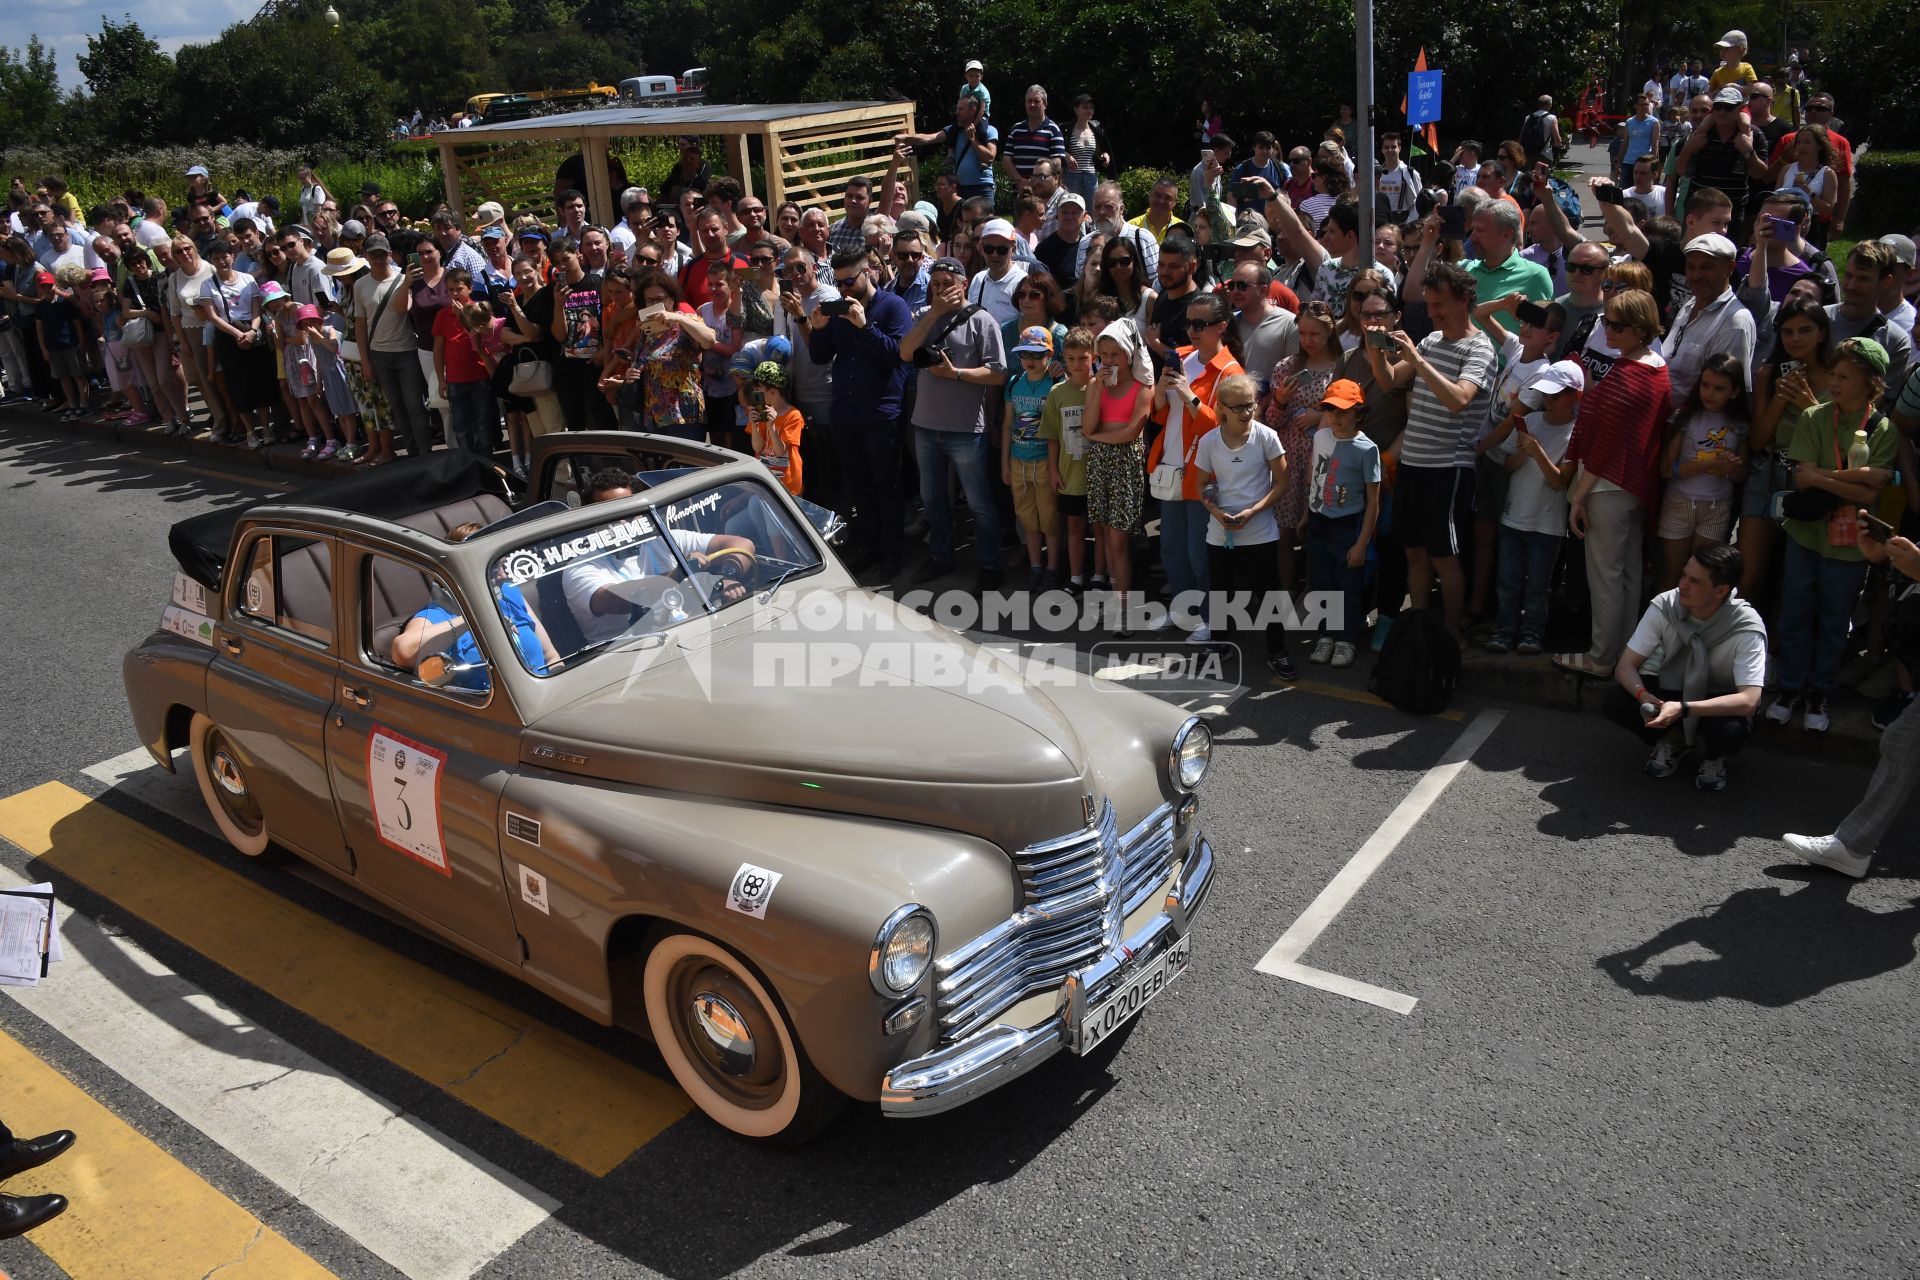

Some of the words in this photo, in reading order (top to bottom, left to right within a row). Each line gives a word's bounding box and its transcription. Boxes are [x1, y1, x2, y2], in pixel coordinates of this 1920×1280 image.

[665, 491, 722, 524] Автострада
[543, 516, 655, 566] НАСЛЕДИЕ
[393, 776, 412, 831] 3
[1168, 944, 1185, 971] 96
